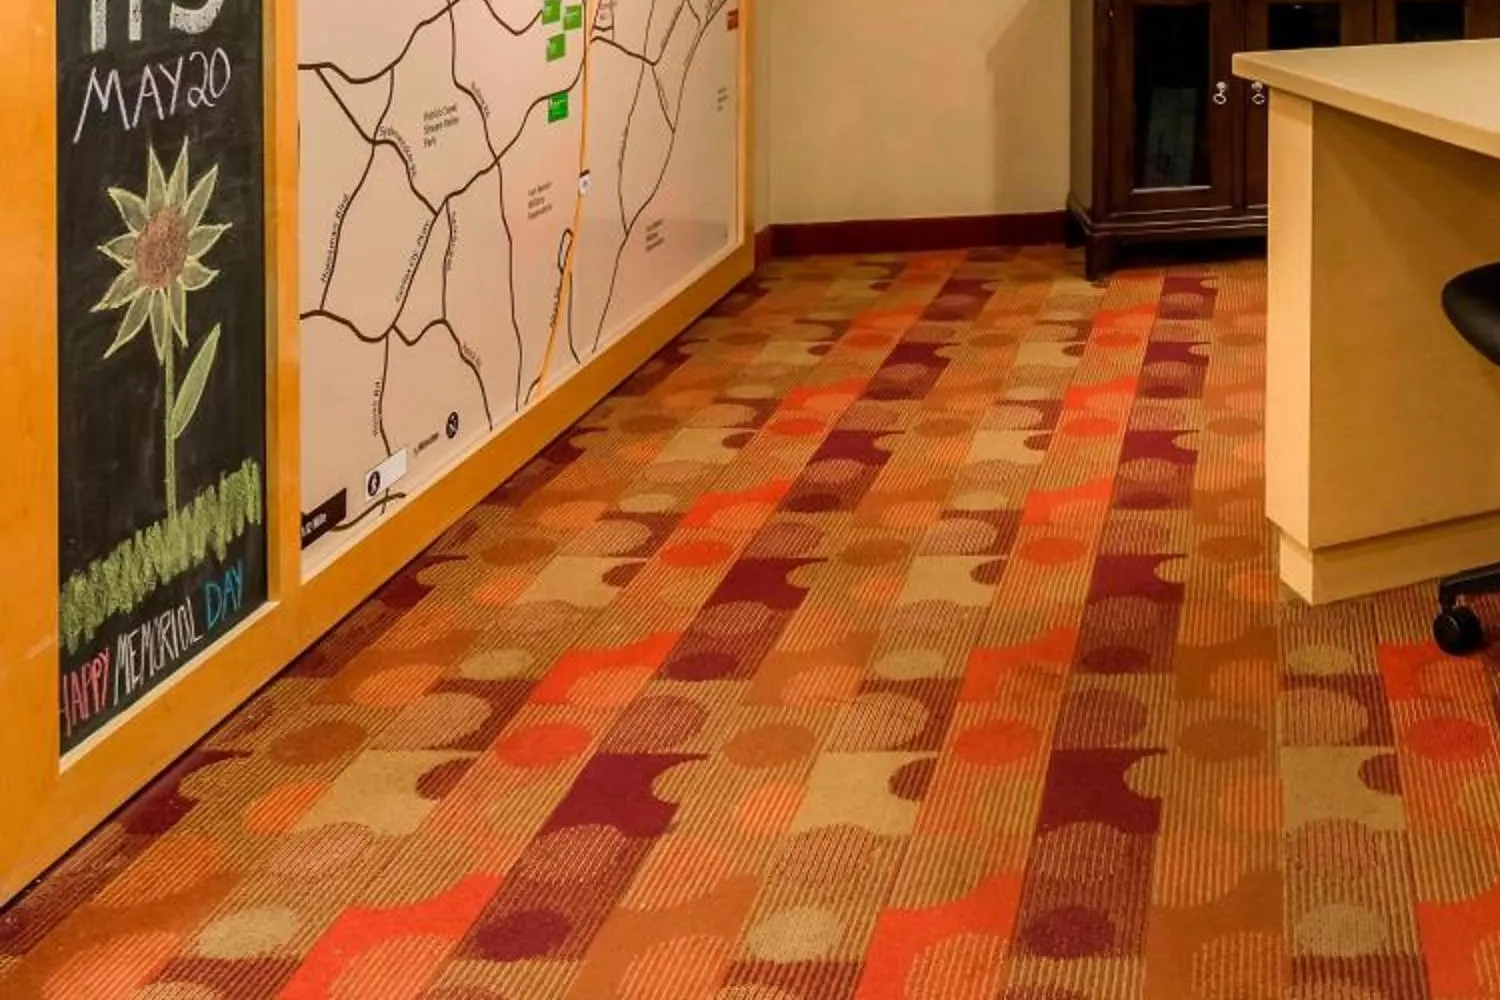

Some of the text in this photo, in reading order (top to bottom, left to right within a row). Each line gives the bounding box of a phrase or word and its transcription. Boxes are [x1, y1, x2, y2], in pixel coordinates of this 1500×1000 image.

[73, 47, 231, 144] MAY 20
[204, 560, 245, 630] DAY
